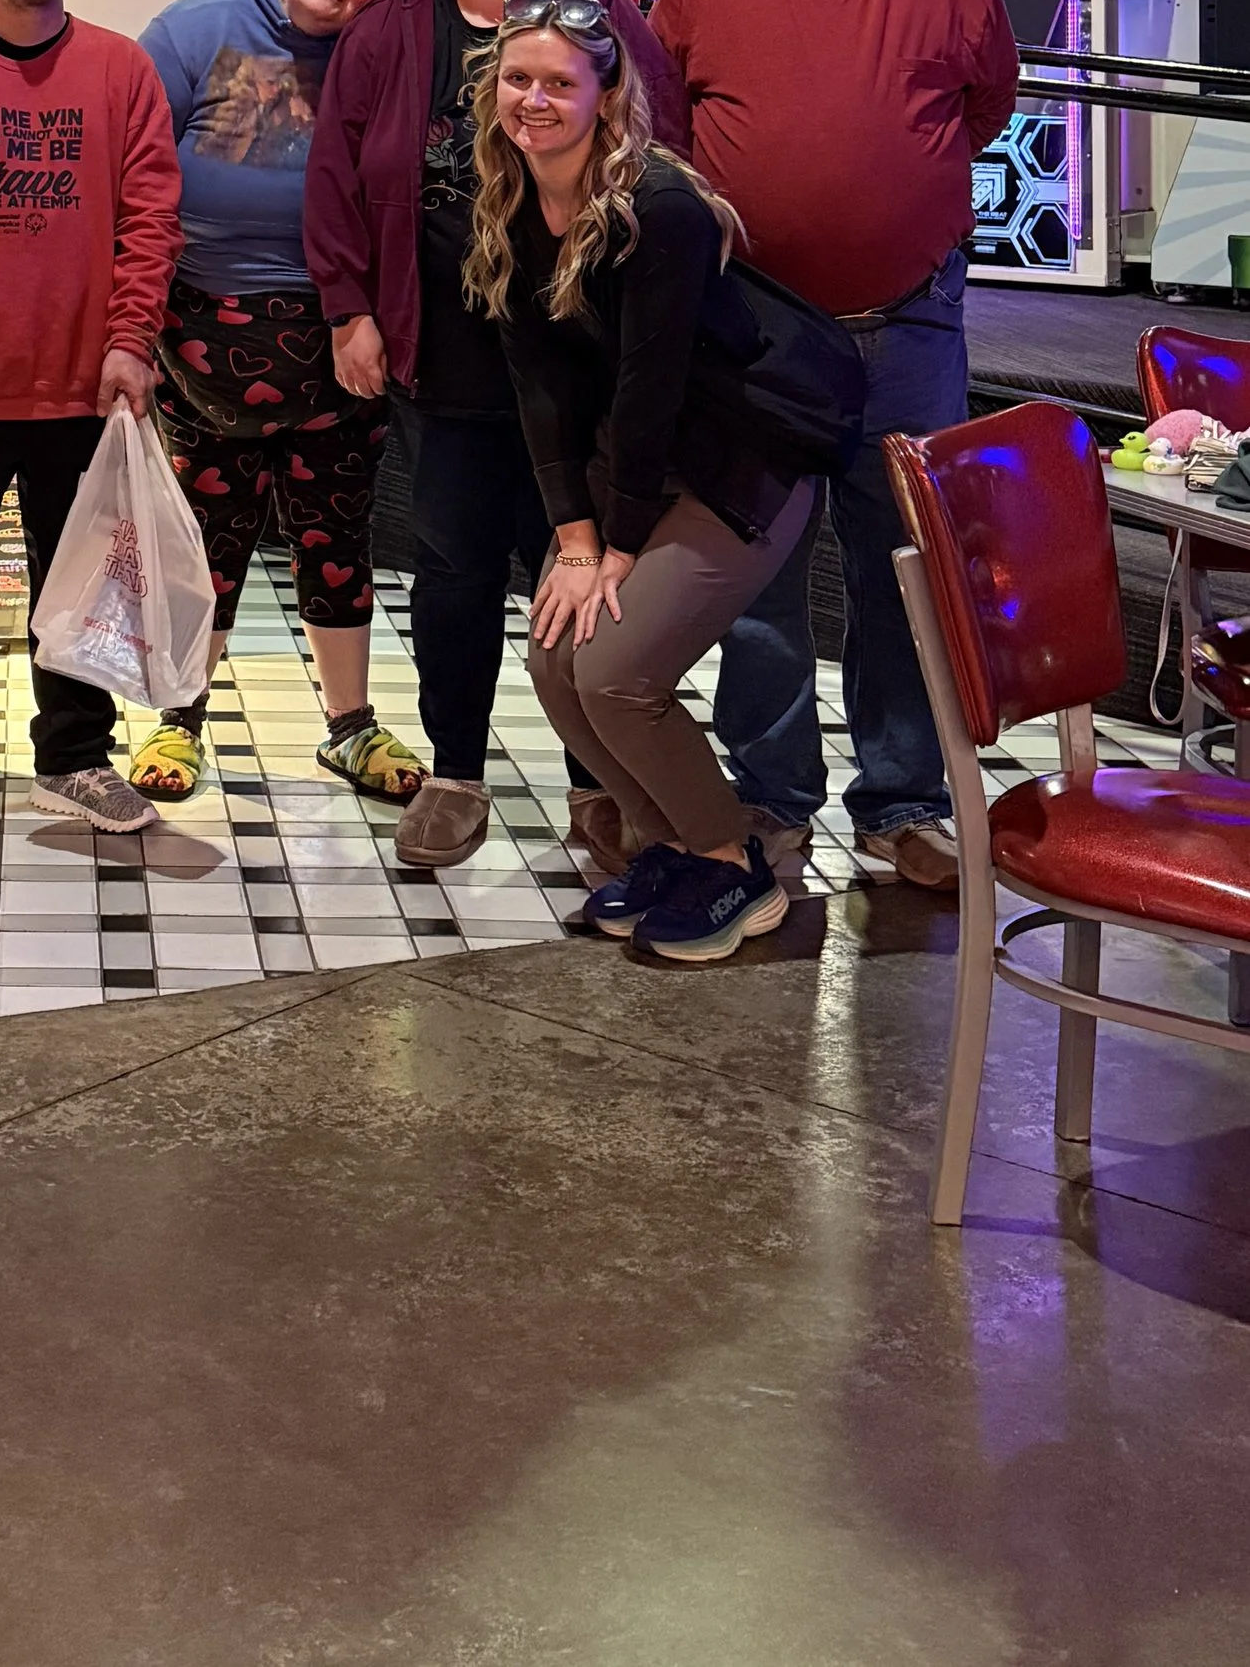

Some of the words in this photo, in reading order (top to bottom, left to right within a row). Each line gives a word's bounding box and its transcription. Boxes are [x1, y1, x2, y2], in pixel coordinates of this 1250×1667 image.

[1, 107, 31, 129] ME
[38, 108, 83, 129] WIN
[3, 126, 52, 141] CANNOT
[56, 127, 83, 138] WIN
[7, 139, 42, 162] ME
[50, 139, 82, 161] BE
[7, 195, 81, 210] ATTEMPT
[708, 886, 747, 925] HOKA
